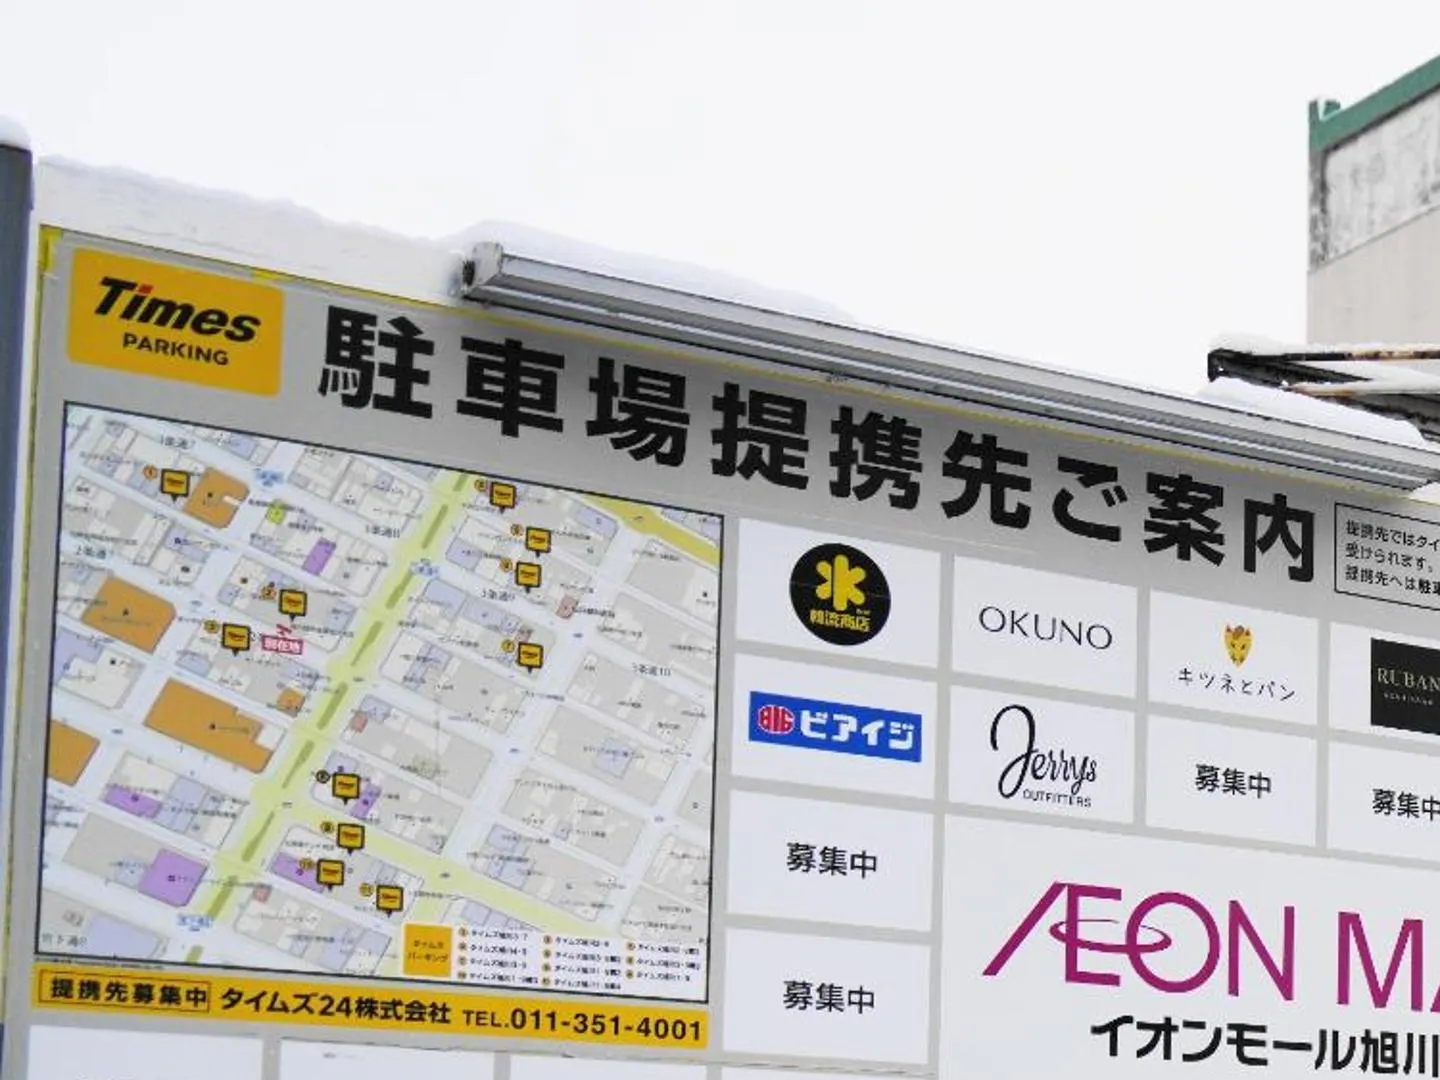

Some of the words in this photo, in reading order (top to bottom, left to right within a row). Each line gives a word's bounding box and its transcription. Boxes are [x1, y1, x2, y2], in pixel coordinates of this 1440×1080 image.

[94, 276, 261, 343] Times
[122, 331, 229, 367] PARKING
[317, 304, 1316, 583] 駐車場提携先ご案内
[978, 606, 1113, 651] OKUNO
[1178, 667, 1296, 701] キツネとパン
[801, 709, 915, 750] ビアイジ
[990, 704, 1097, 799] Jerrys
[1023, 788, 1092, 808] OUTFITTERS
[1195, 763, 1272, 799] 募集中
[786, 842, 878, 880] 募集中
[50, 976, 208, 1009] 提携先募集中
[220, 987, 451, 1024] タイムズ24株式会社
[782, 981, 876, 1016] 募集中
